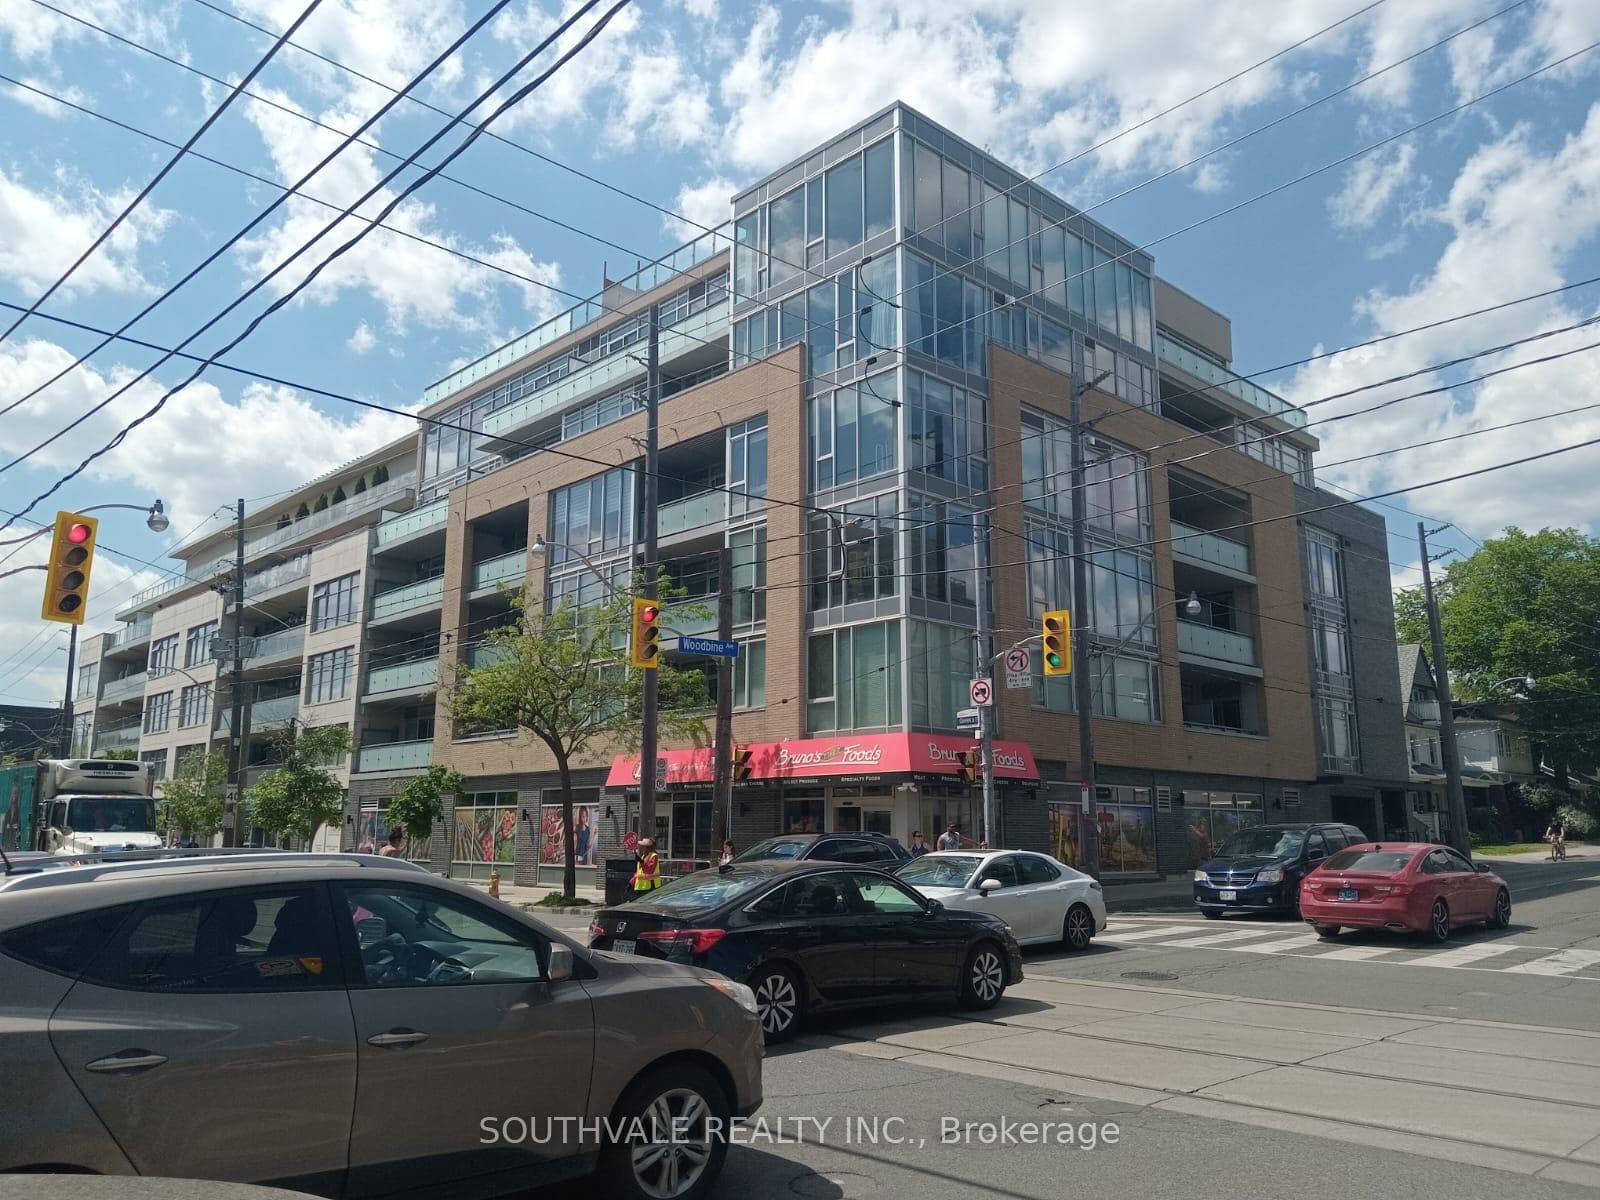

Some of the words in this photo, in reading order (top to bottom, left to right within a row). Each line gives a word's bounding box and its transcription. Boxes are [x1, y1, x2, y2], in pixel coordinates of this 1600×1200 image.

[683, 638, 724, 653] Woodbine
[776, 749, 822, 765] Bruno's
[842, 744, 881, 762] Foods
[928, 743, 960, 761] Brun
[992, 749, 1024, 767] Foods
[226, 791, 238, 801] 40
[624, 834, 637, 849] STOP
